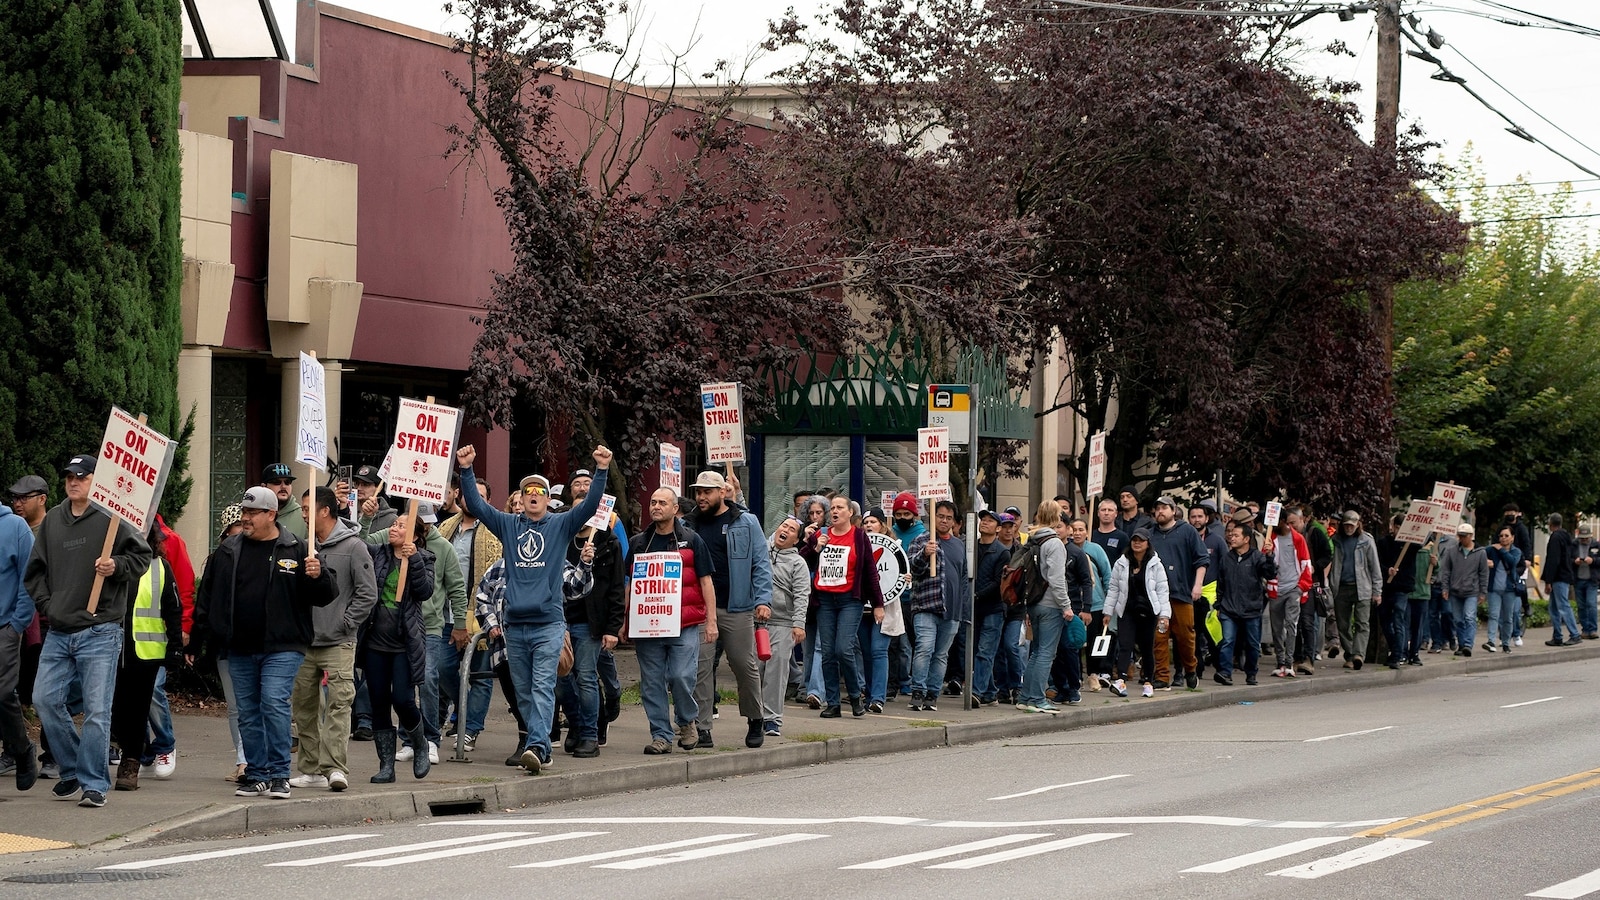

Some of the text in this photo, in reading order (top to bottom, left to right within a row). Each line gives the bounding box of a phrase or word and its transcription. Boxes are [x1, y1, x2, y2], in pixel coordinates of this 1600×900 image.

[714, 392, 728, 406] ON
[403, 402, 456, 415] AEROSPACE MACHINISTS
[416, 413, 438, 433] ON
[706, 409, 738, 425] STRIKE
[114, 412, 166, 446] AEROSPACE MACHINISTS
[125, 430, 148, 456] ON
[397, 432, 450, 457] STRIKE
[928, 435, 939, 448] ON
[104, 442, 157, 486] STRIKE
[920, 451, 947, 464] STRIKE
[661, 471, 679, 487] STRIKE
[391, 484, 442, 500] AT BOEING
[1444, 489, 1456, 499] ON
[92, 491, 142, 527] AT BOEING
[1419, 506, 1431, 514] ON
[1406, 514, 1434, 525] STRIKE
[870, 535, 900, 554] HERE!
[648, 563, 663, 577] ON
[821, 567, 843, 578] ENOUGH
[635, 580, 677, 594] STRIKE
[638, 603, 672, 615] Boeing
